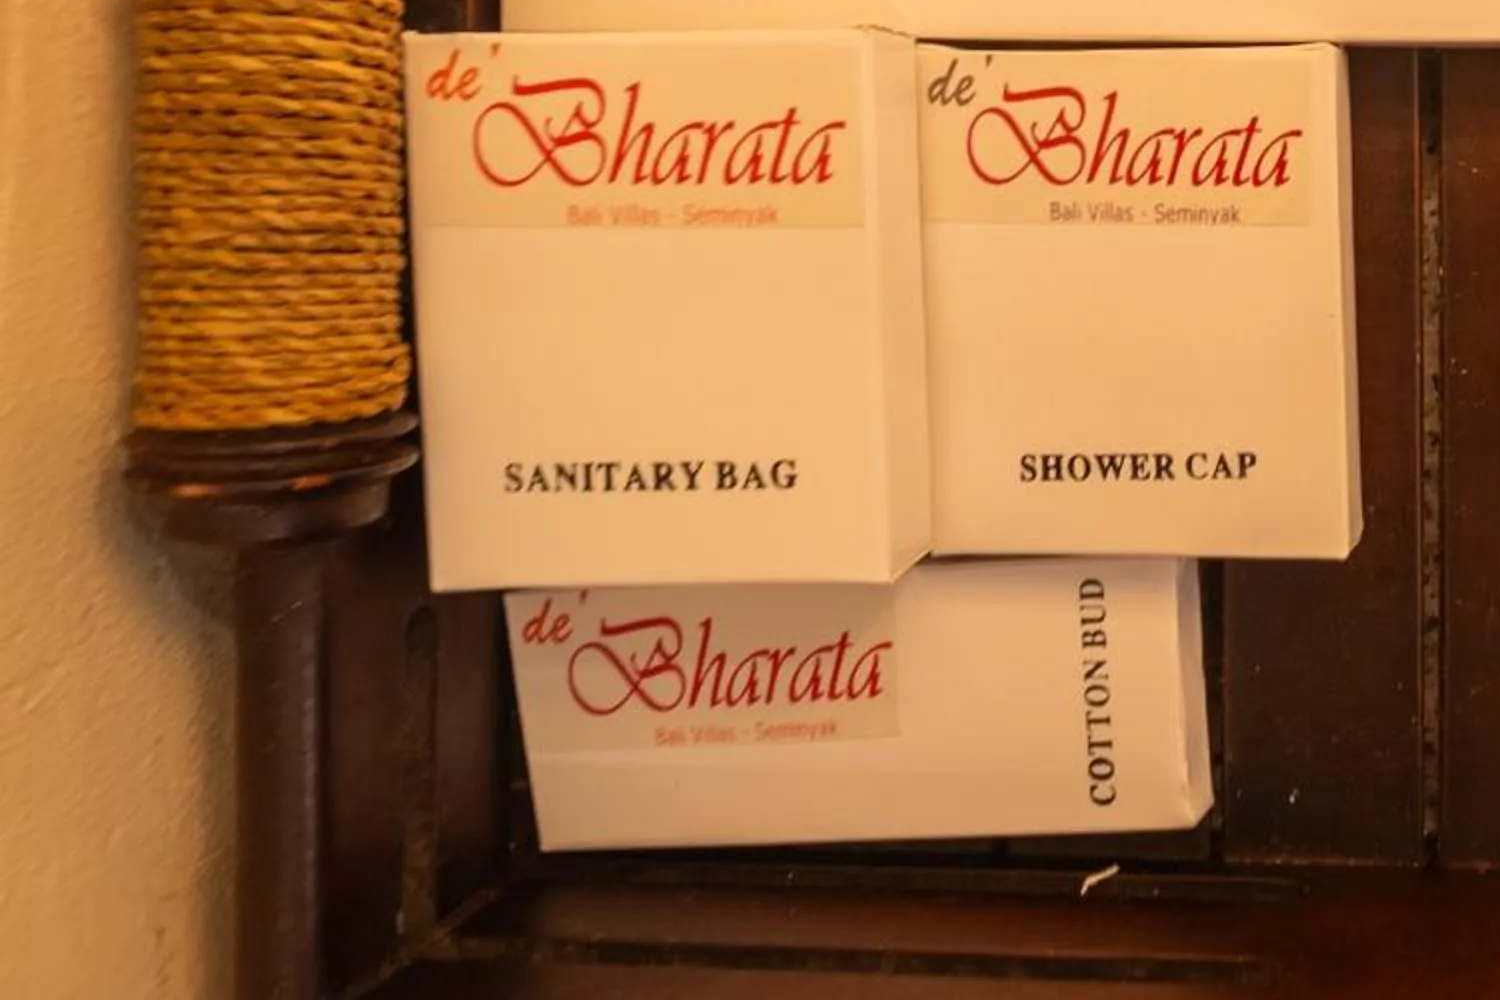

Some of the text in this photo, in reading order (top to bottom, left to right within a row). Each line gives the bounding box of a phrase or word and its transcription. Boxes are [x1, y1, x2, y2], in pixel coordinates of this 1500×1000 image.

[473, 75, 847, 188] Bharata
[967, 82, 1303, 188] Bharata
[566, 204, 602, 227] Bali
[610, 204, 660, 226] Villas
[681, 205, 780, 229] Seminyak
[1049, 202, 1083, 223] Bali
[1087, 202, 1135, 223] Villas
[1154, 203, 1242, 227] Seminyak
[505, 460, 799, 492] SANITARY BAG
[1020, 452, 1258, 482] SHOWER CAP
[568, 617, 893, 717] Bharata
[1079, 578, 1116, 807] COTTON BUD
